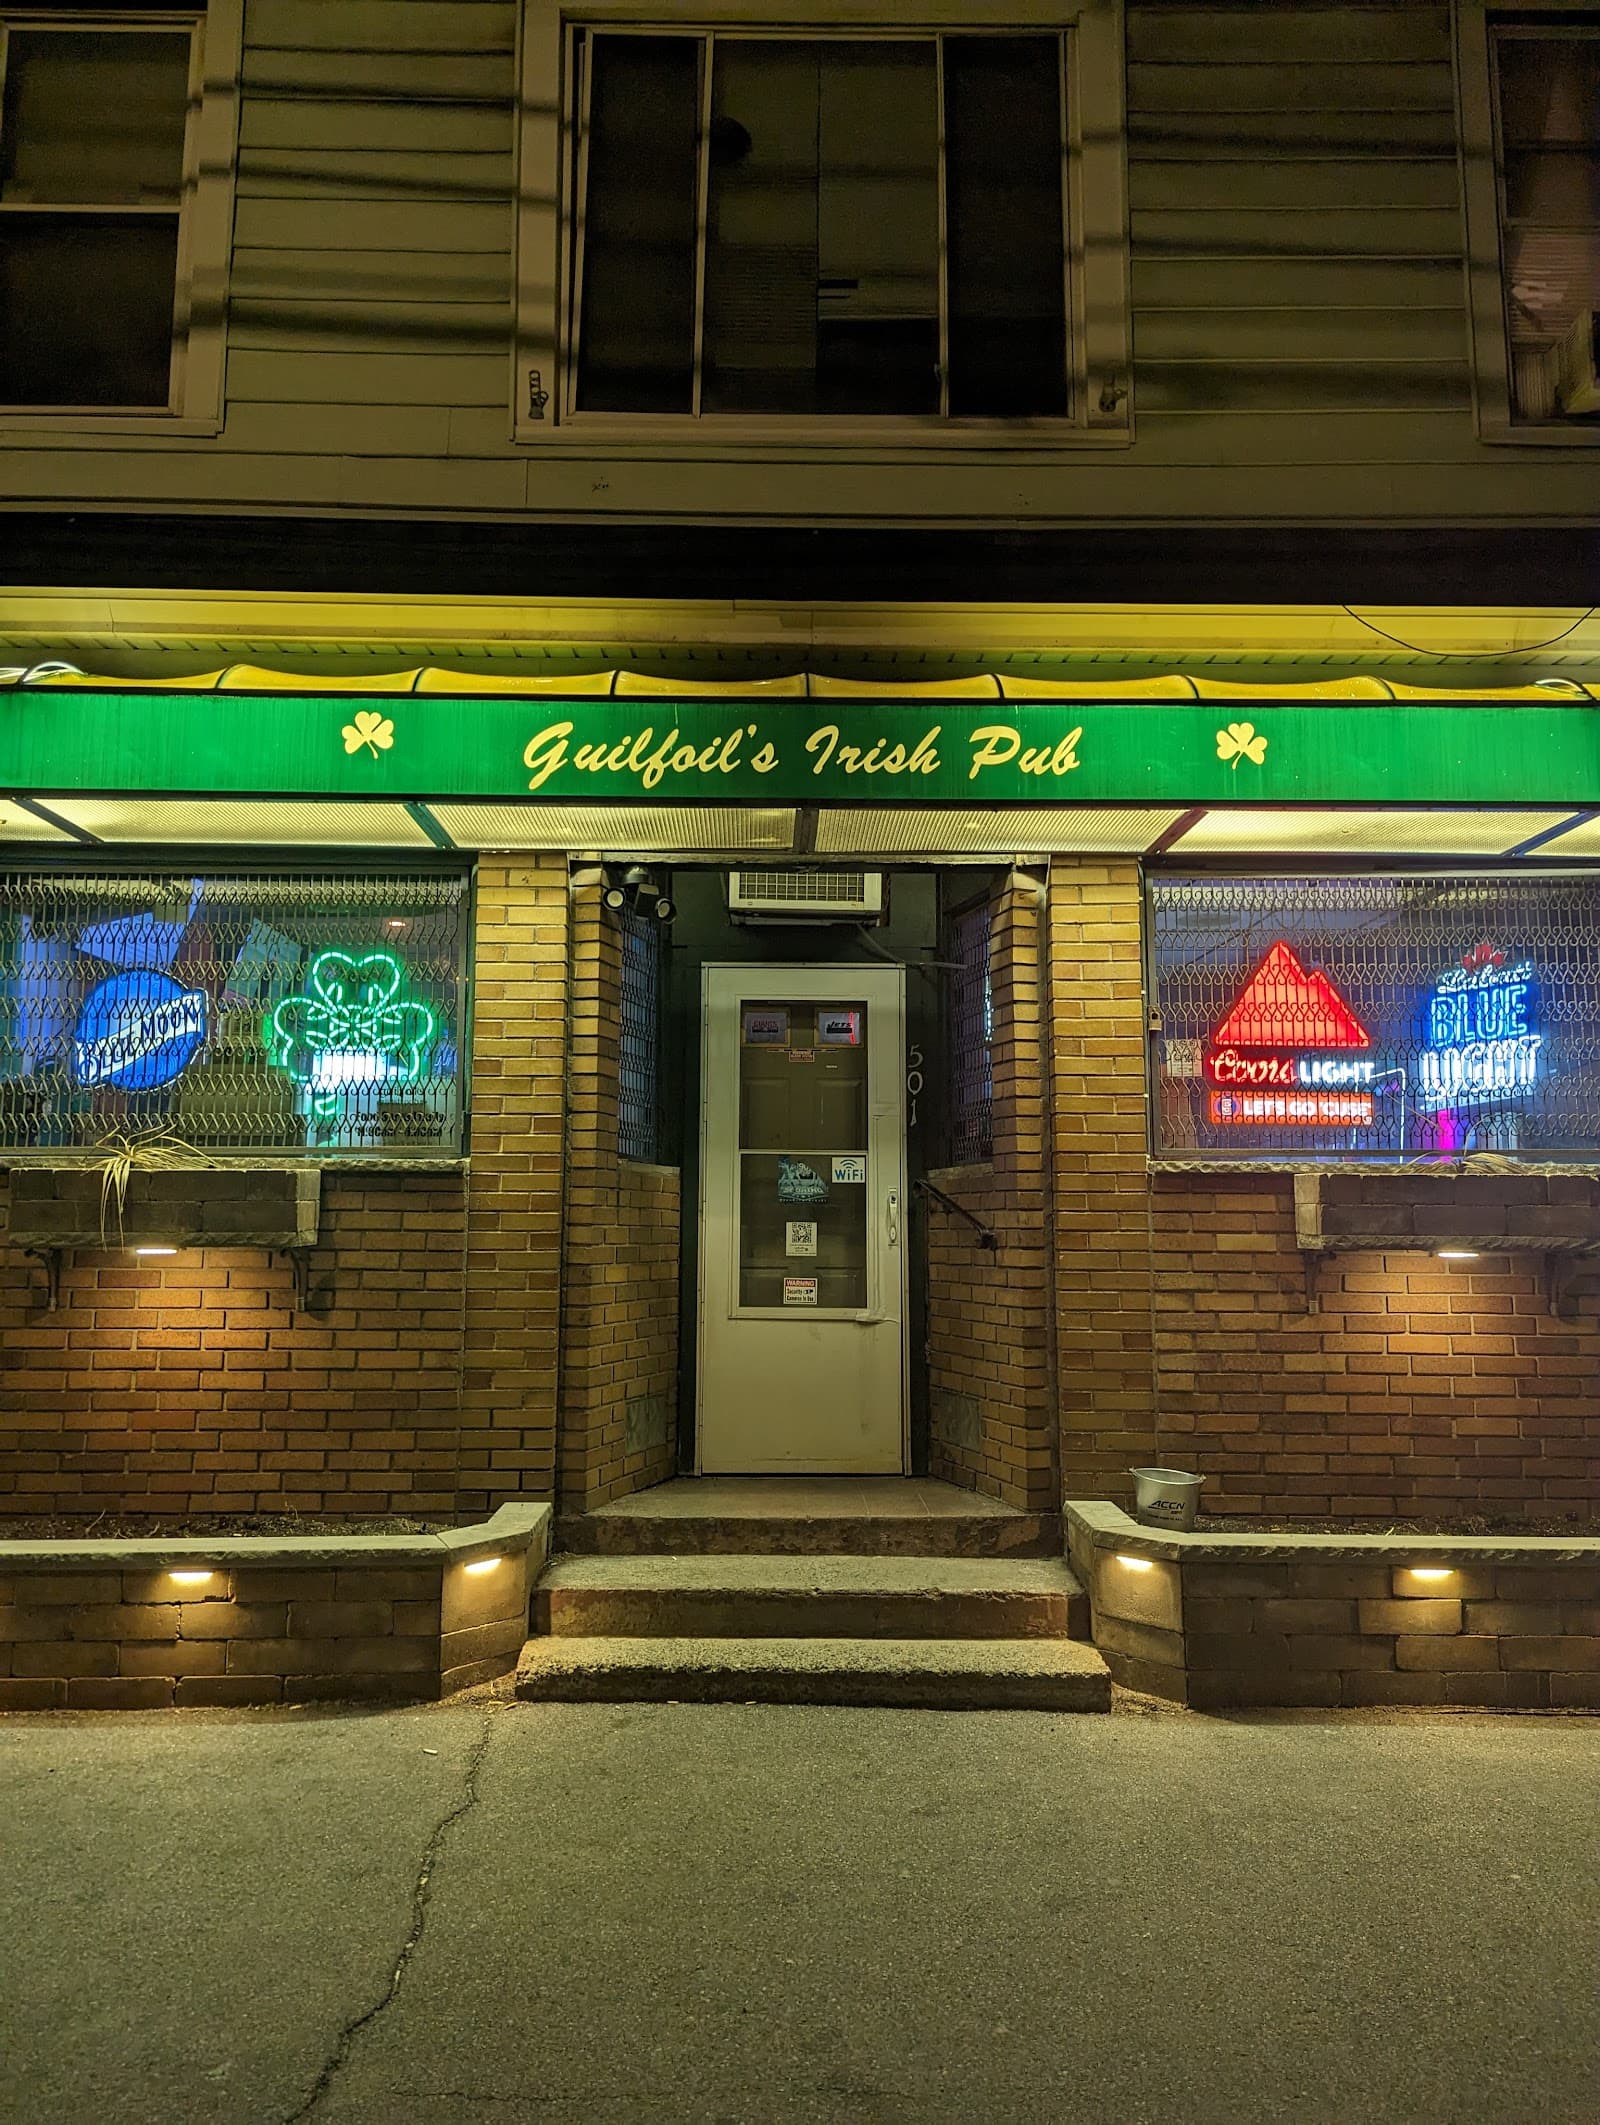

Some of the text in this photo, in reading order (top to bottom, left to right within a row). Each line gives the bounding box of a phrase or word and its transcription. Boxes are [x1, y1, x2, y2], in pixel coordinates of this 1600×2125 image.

[523, 721, 1084, 790] Guilfoil's Irish Pub
[80, 1000, 200, 1084] BLUE MOON
[1430, 984, 1528, 1048] BLUE
[906, 1043, 924, 1128] 501
[1209, 1049, 1297, 1084] Coors
[1298, 1060, 1375, 1083] LIGHT
[1423, 1034, 1543, 1101] LIGHT
[1289, 1101, 1317, 1116] GO
[834, 1169, 864, 1181] WiFi
[1149, 1501, 1185, 1510] ACCN
